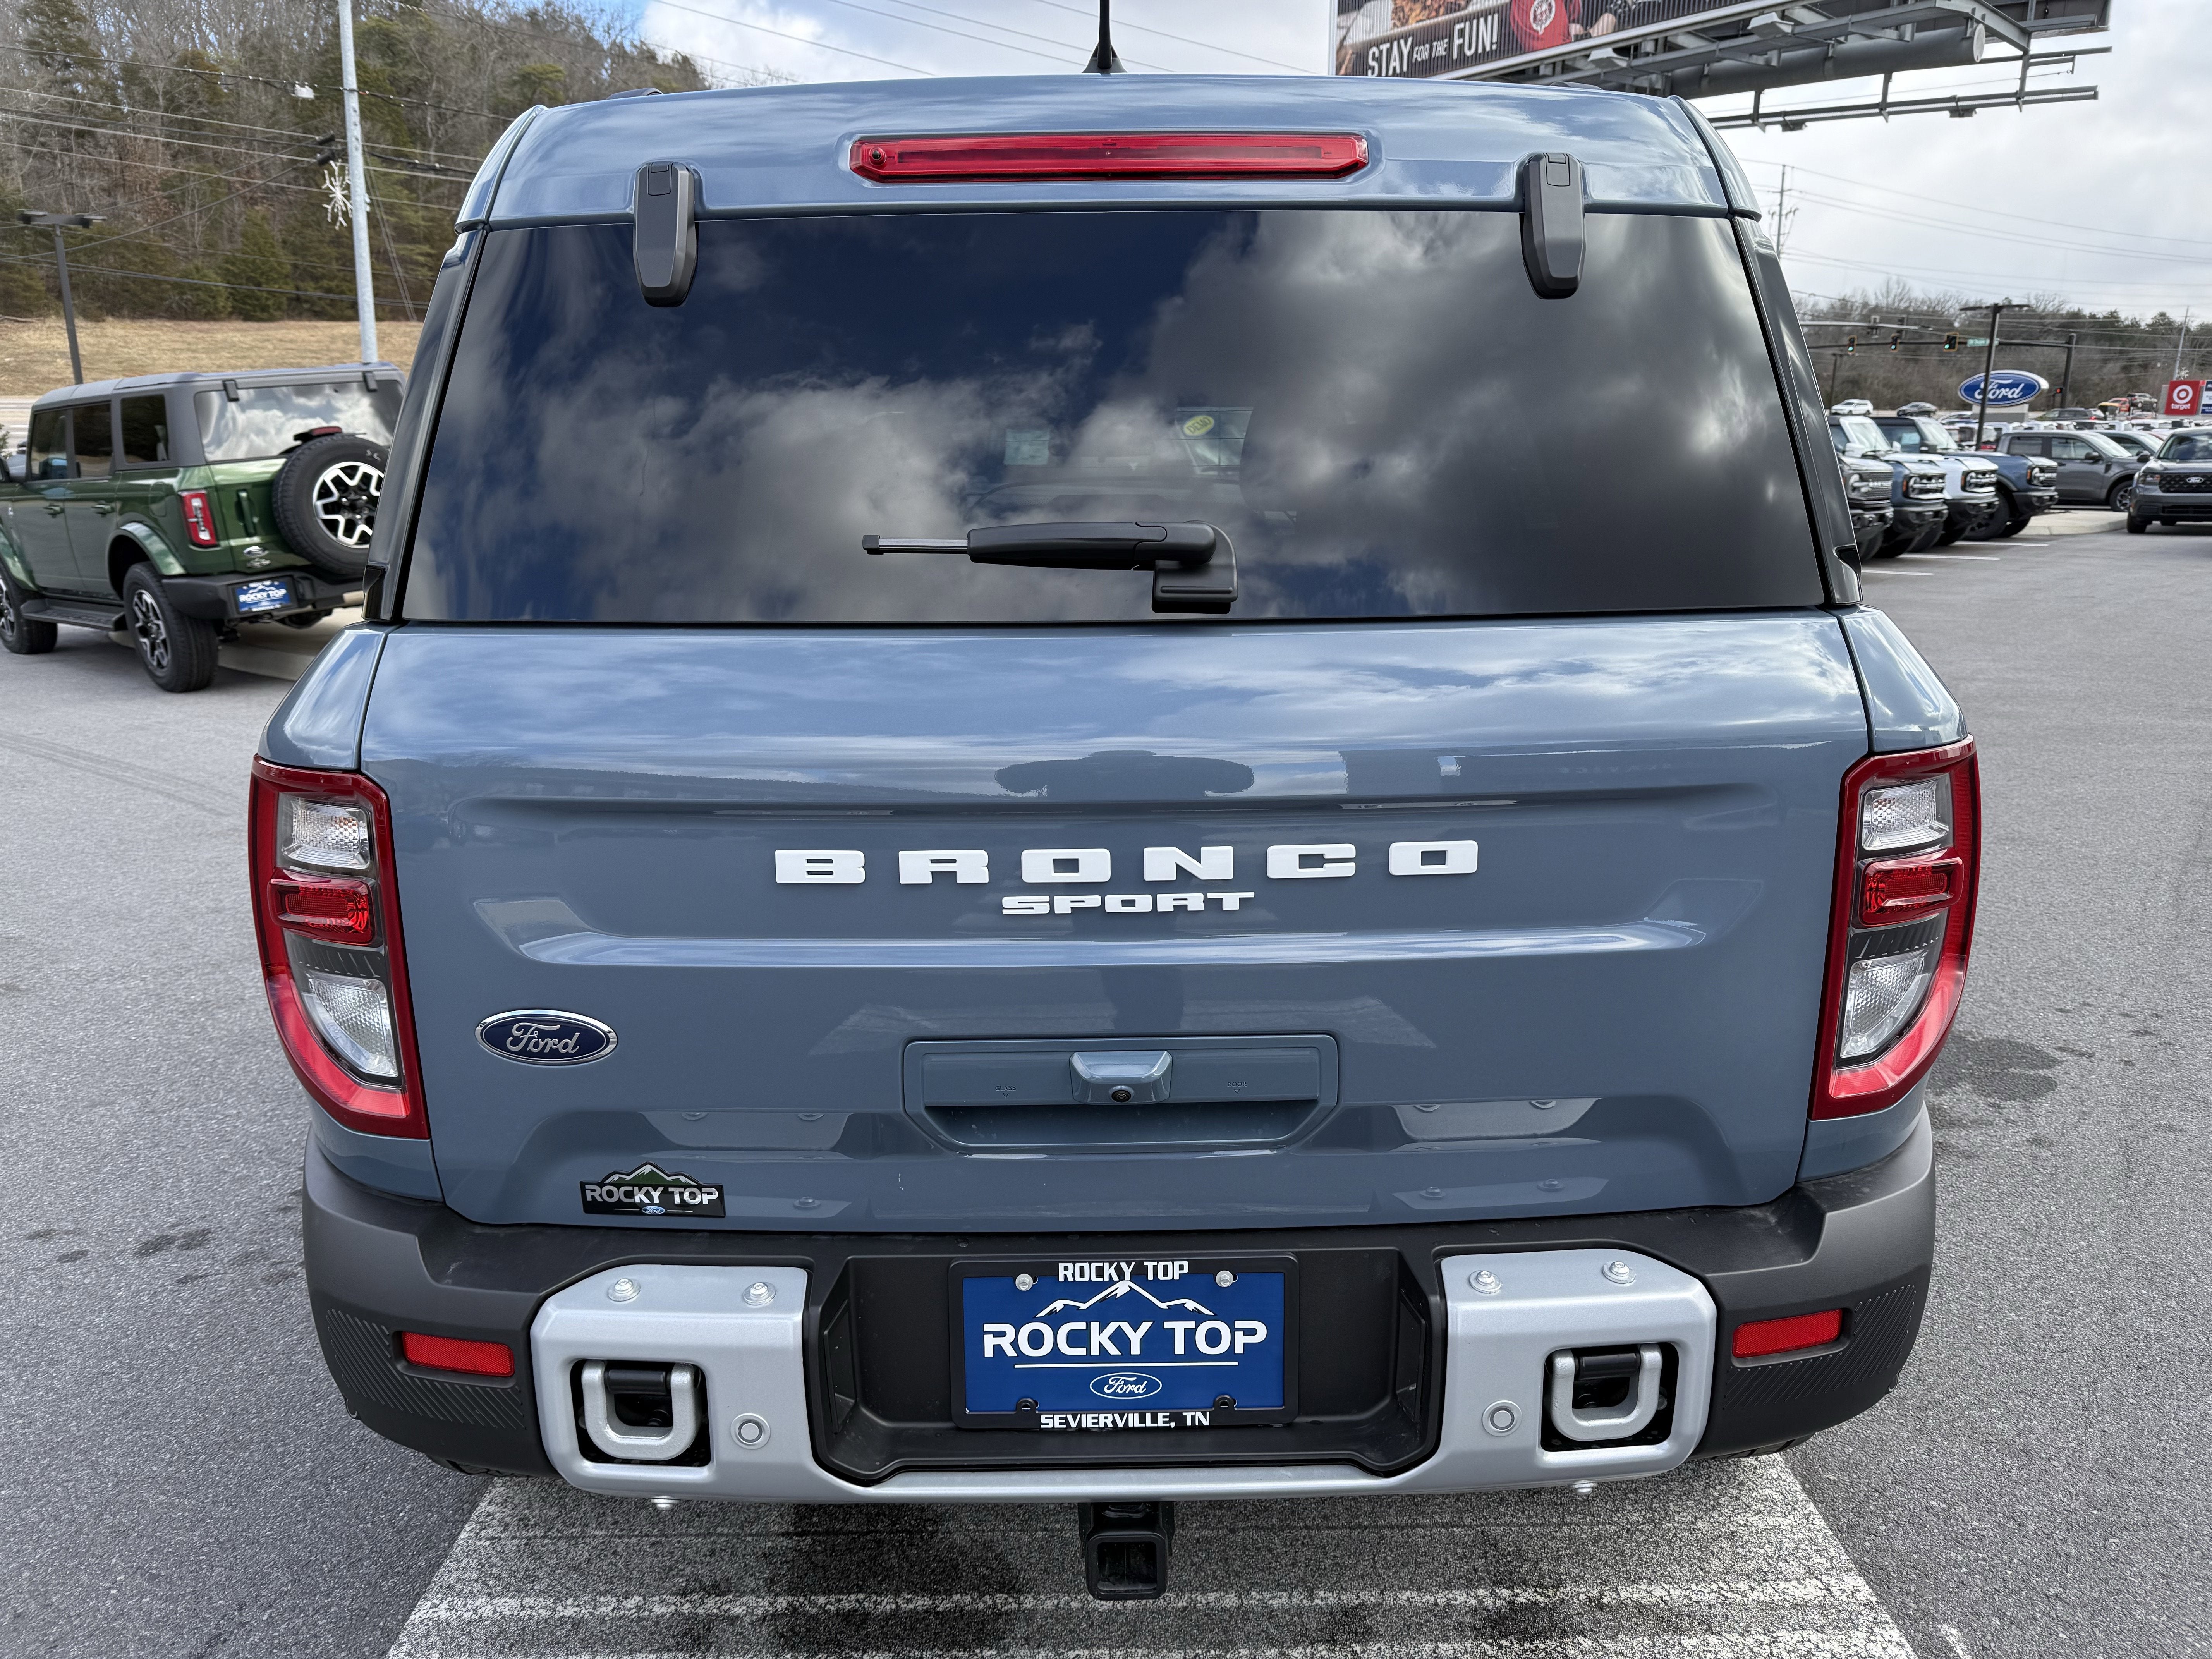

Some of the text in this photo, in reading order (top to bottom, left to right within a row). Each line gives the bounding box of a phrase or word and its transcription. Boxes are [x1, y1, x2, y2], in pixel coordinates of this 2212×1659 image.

[1368, 36, 1413, 77] STAY
[1413, 43, 1430, 63] FOR
[1432, 39, 1449, 57] THE
[1453, 13, 1499, 60] FUN!
[1974, 379, 2025, 400] Ford
[239, 589, 287, 602] ROCKY TOP
[775, 840, 1479, 884] BRONCO
[1002, 891, 1255, 915] SPORT
[506, 1022, 580, 1054] Ford
[585, 1185, 719, 1205] ROCKY TOP
[1058, 1261, 1189, 1282] ROCKY TOP
[983, 1320, 1267, 1357] ROCKY TOP
[1104, 1376, 1147, 1394] Ford
[1040, 1412, 1210, 1428] SEVIERVILLE, TN
